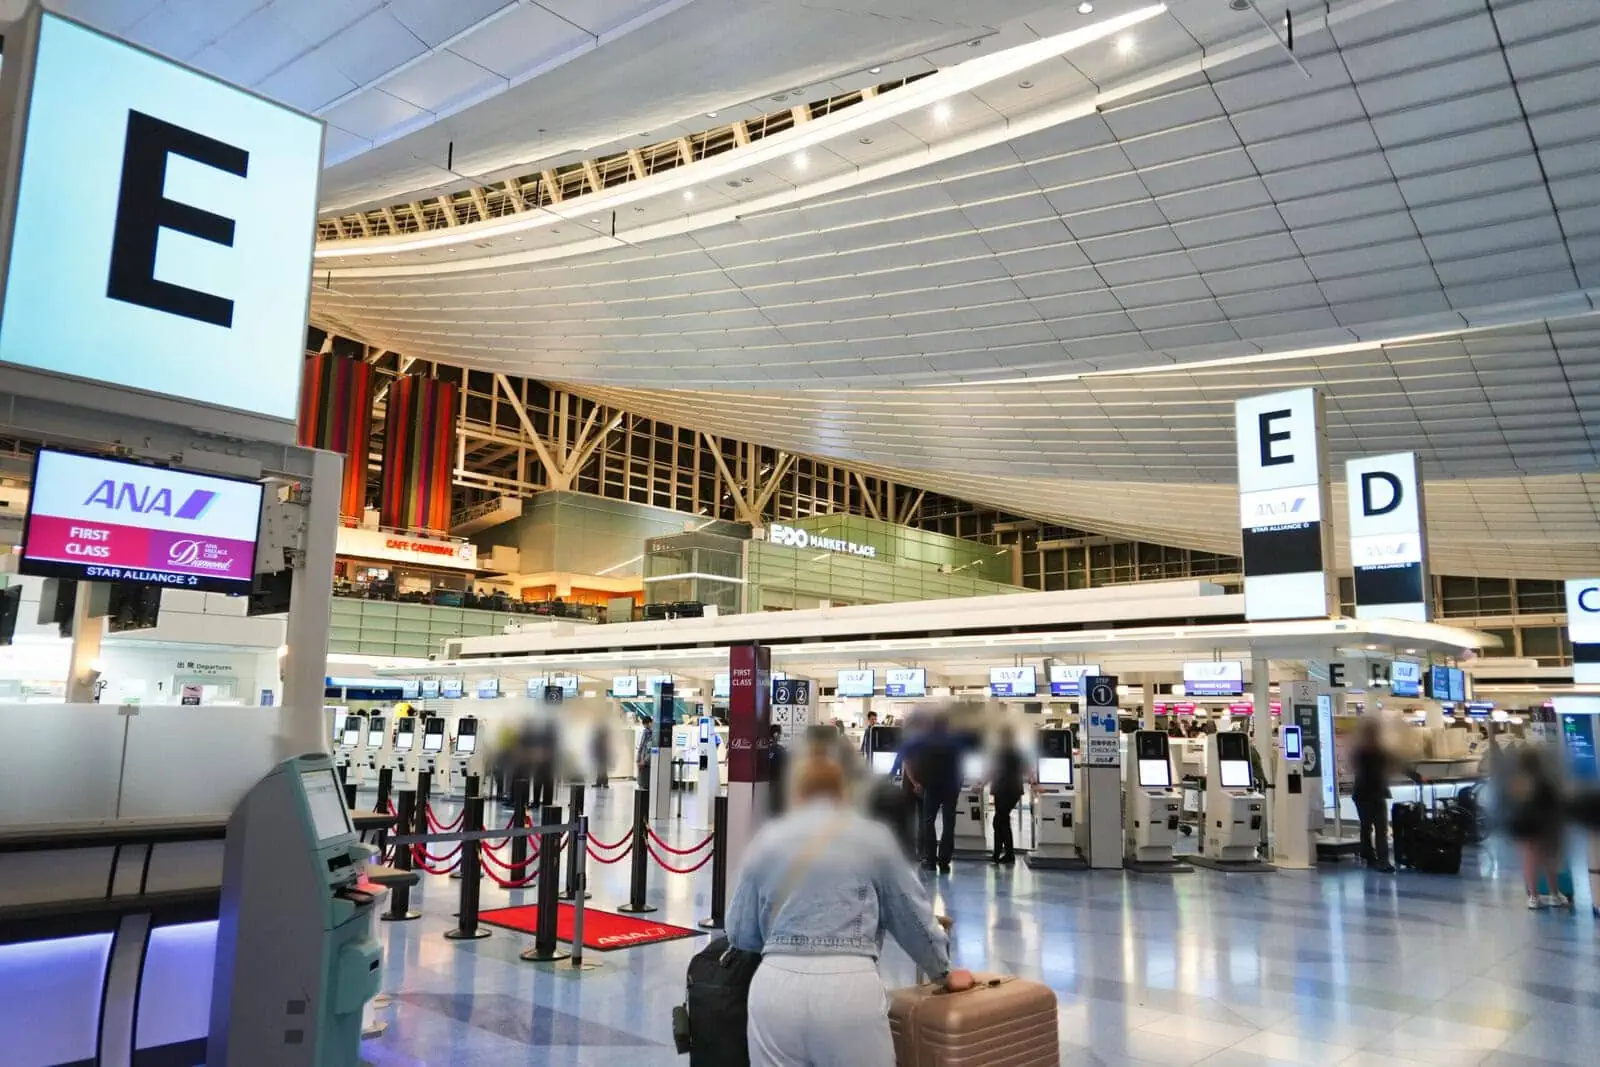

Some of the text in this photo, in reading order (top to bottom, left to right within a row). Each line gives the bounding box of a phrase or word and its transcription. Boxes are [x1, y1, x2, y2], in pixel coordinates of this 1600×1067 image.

[106, 108, 249, 328] E
[1258, 408, 1295, 467] E
[82, 479, 172, 517] ANA
[1361, 471, 1403, 517] D
[70, 526, 111, 541] FIRST
[770, 523, 876, 557] EDO MARKET PLACE
[65, 543, 110, 558] CLASS
[386, 540, 409, 550] CAFE
[86, 566, 185, 584] STAR ALLIANCE
[196, 663, 233, 671] Departures
[733, 669, 752, 677] FIRST
[1329, 663, 1345, 687] E
[732, 679, 752, 687] CLASS
